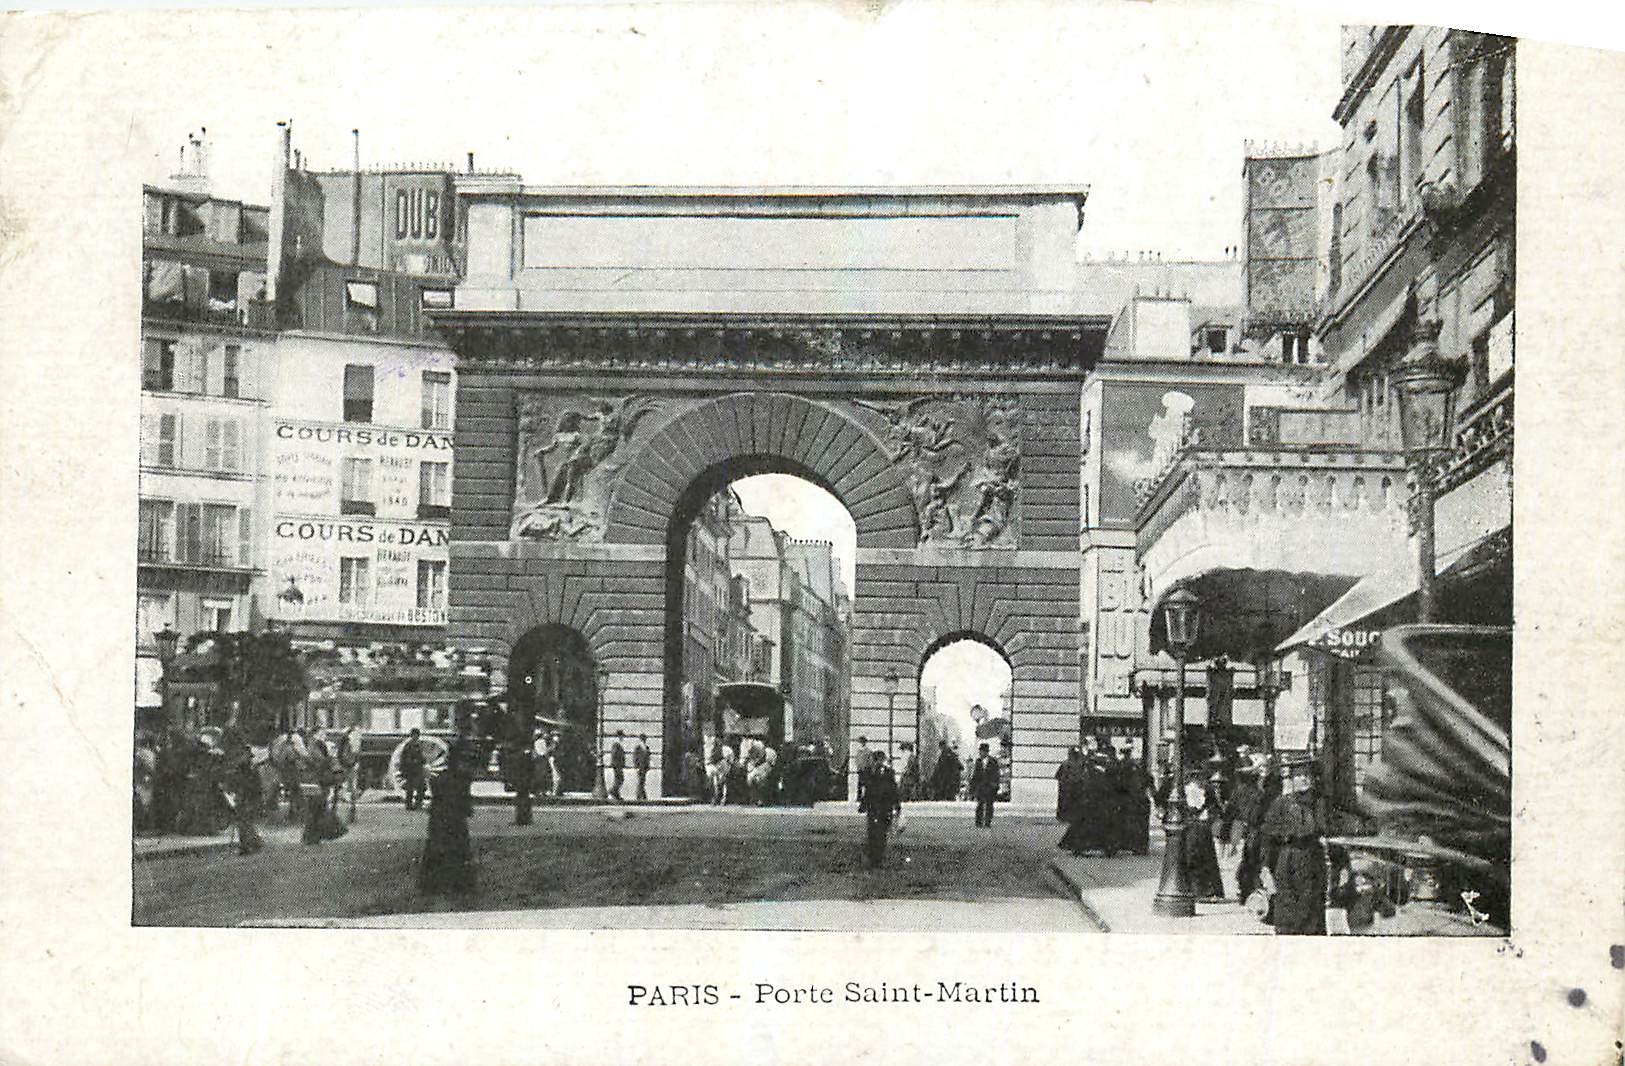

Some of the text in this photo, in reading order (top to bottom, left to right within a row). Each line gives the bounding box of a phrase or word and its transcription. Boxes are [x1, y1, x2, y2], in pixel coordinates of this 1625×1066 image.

[276, 425, 372, 445] COURS
[376, 432, 398, 447] de
[275, 521, 374, 543] COURS
[378, 529, 395, 543] de
